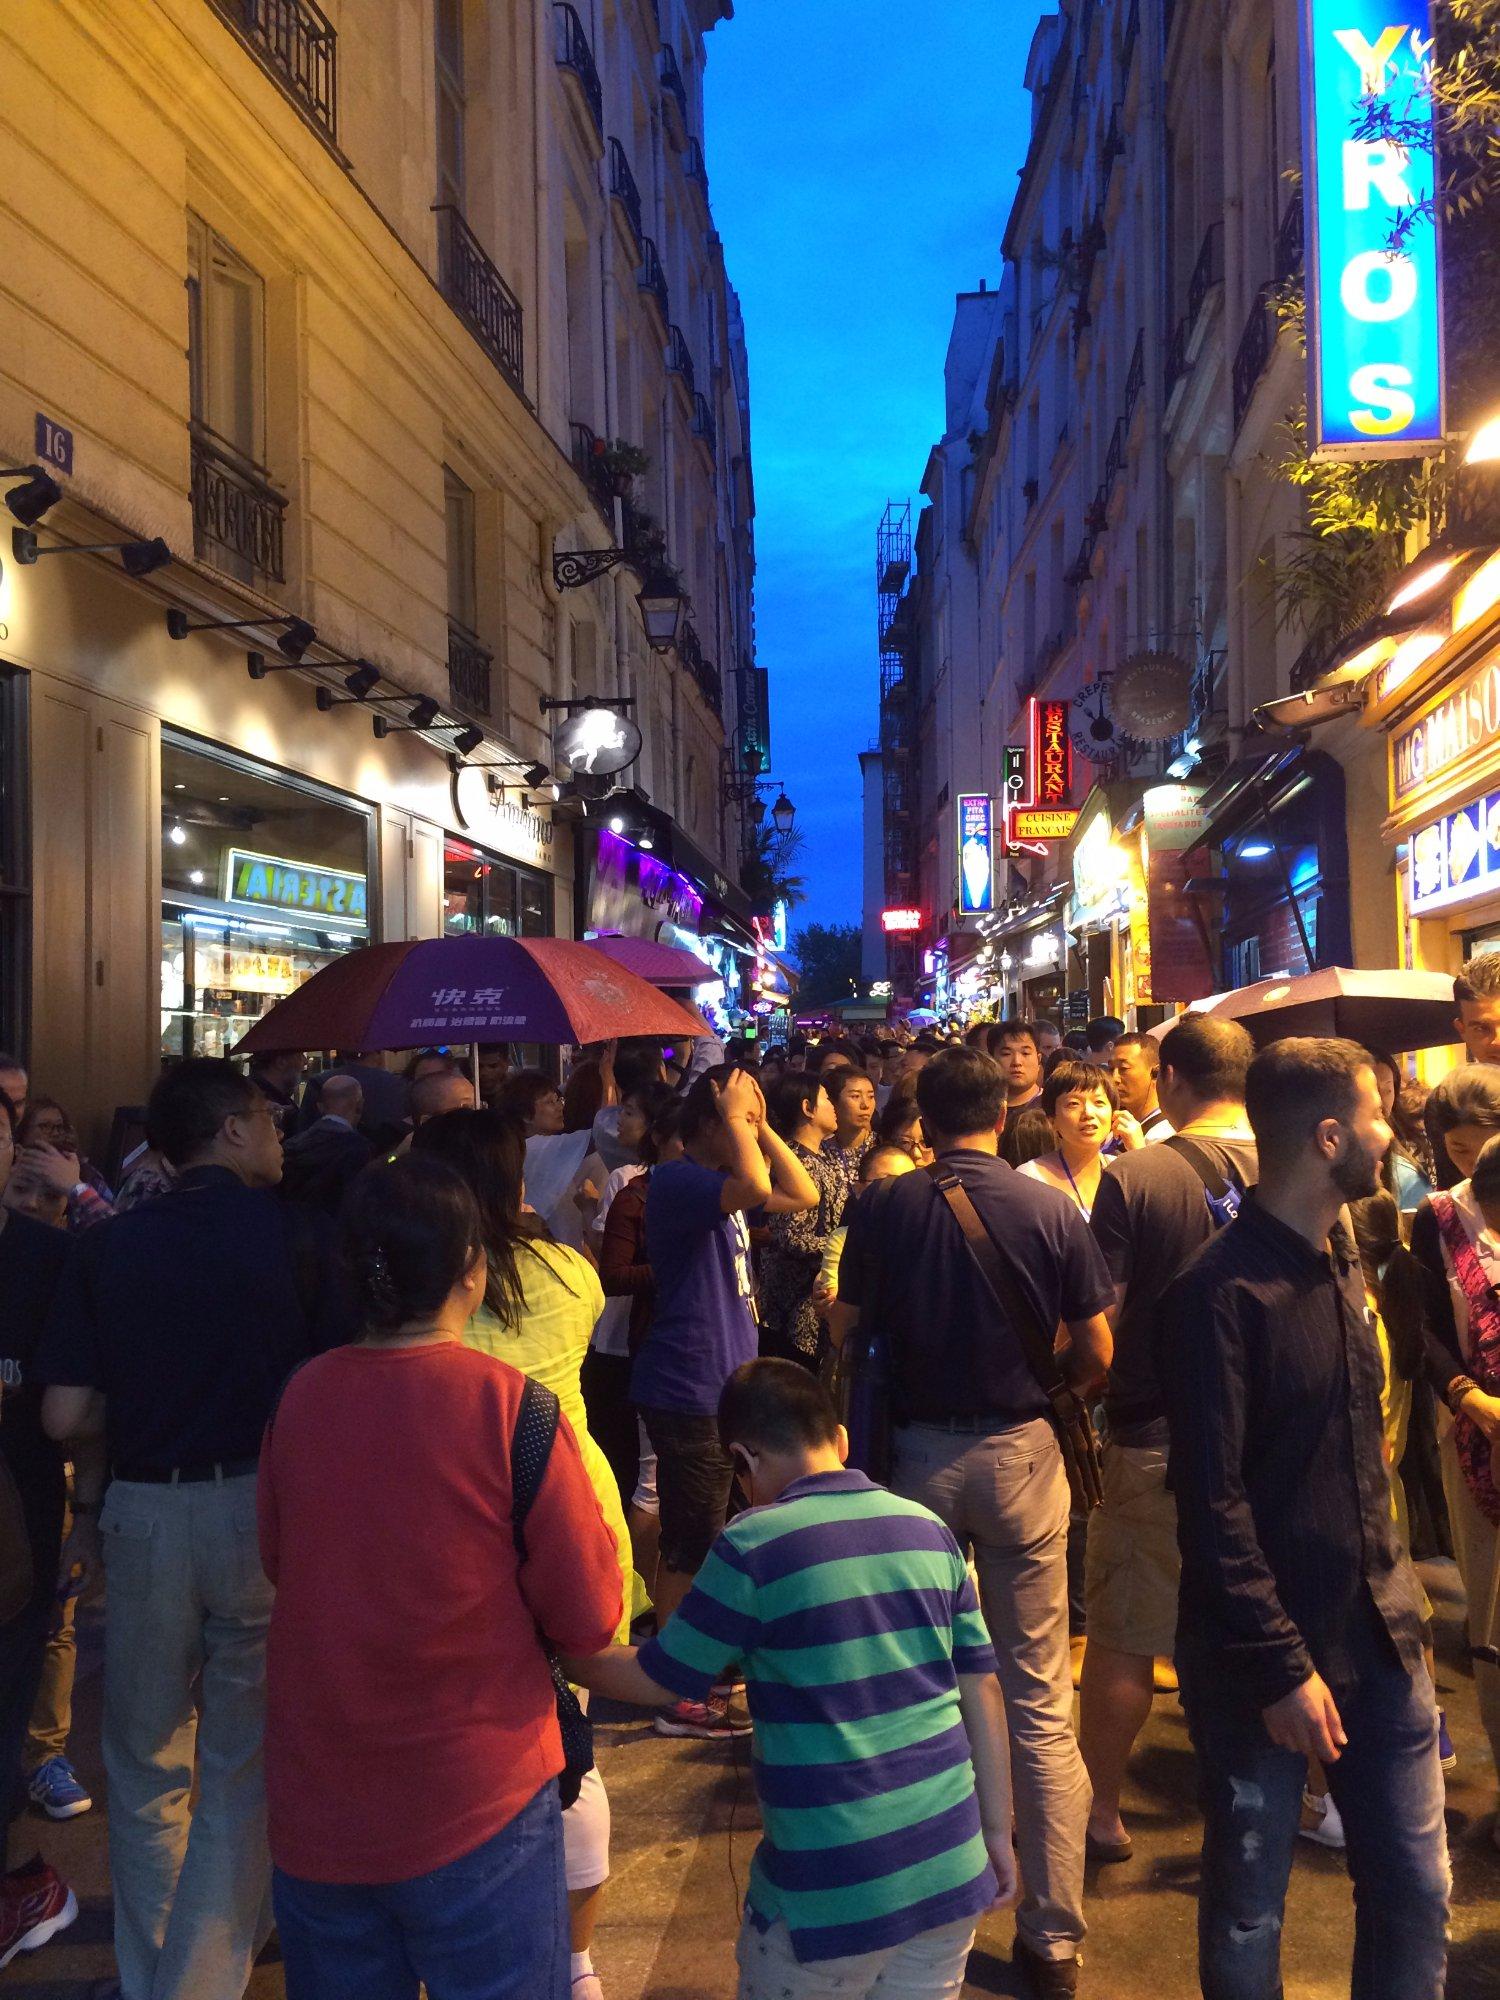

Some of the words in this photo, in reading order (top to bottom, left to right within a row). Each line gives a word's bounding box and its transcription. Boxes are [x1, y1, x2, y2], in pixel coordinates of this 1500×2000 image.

[45, 423, 66, 463] 16
[1044, 702, 1065, 805] RESTAURANT
[965, 814, 986, 822] GREC
[1026, 813, 1071, 823] CUISINE
[432, 988, 504, 1006] 快克
